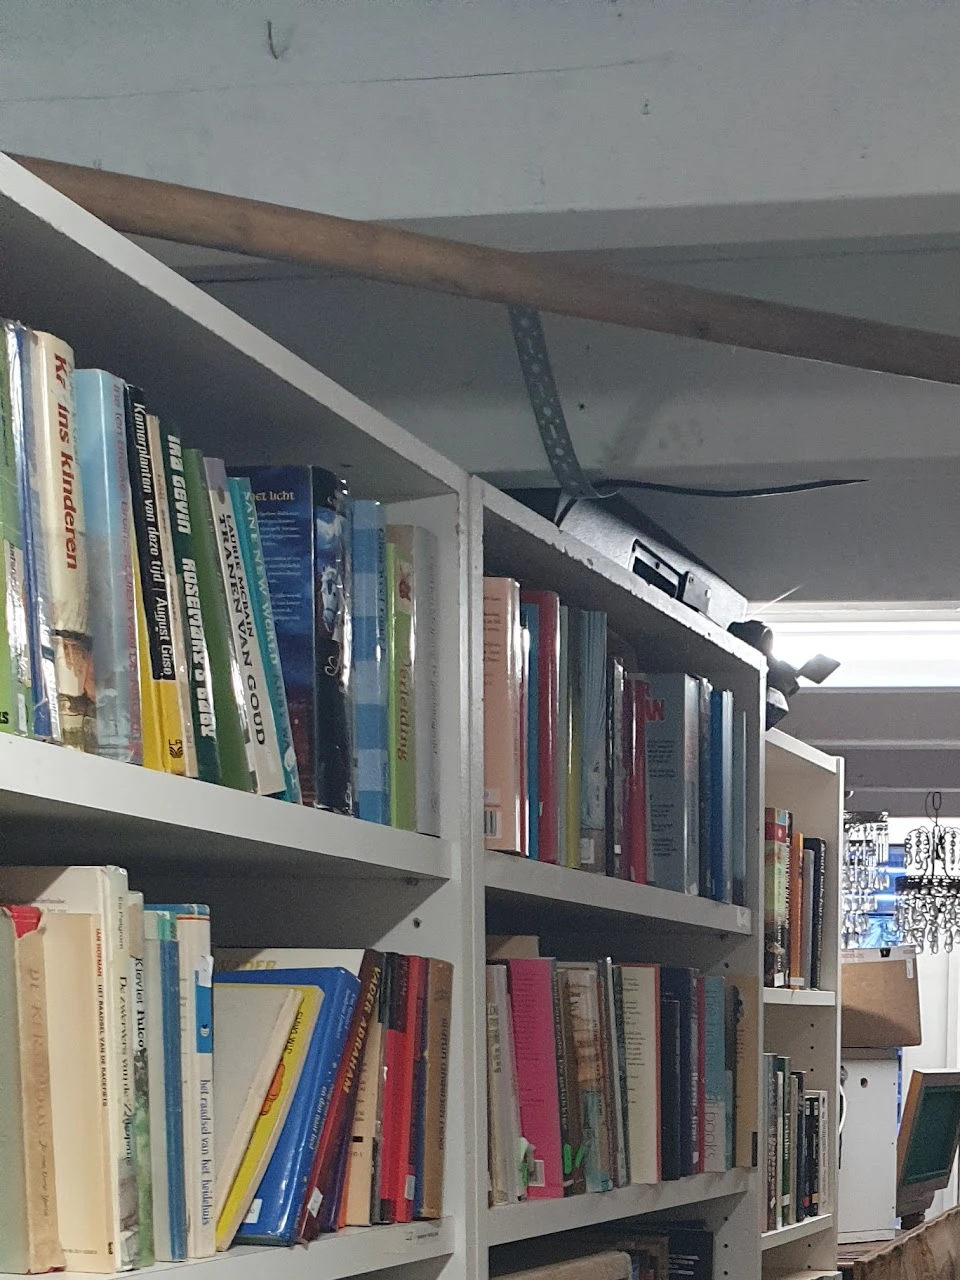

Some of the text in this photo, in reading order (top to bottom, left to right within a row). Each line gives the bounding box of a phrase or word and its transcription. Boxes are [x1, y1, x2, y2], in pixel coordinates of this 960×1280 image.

[132, 403, 152, 493] Kamerplanten
[61, 452, 79, 571] kinderen
[144, 500, 156, 523] van
[147, 527, 161, 556] deze
[148, 559, 164, 583] tijd
[253, 550, 269, 596] NEW
[153, 598, 170, 639] August
[218, 514, 266, 745] TRANEN VAN GOUD
[364, 966, 382, 1014] VADER
[343, 1016, 367, 1094] ABRAHAM
[200, 1079, 212, 1096] het
[201, 1097, 212, 1136] raadsel
[201, 1138, 211, 1156] van
[201, 1159, 212, 1175] het
